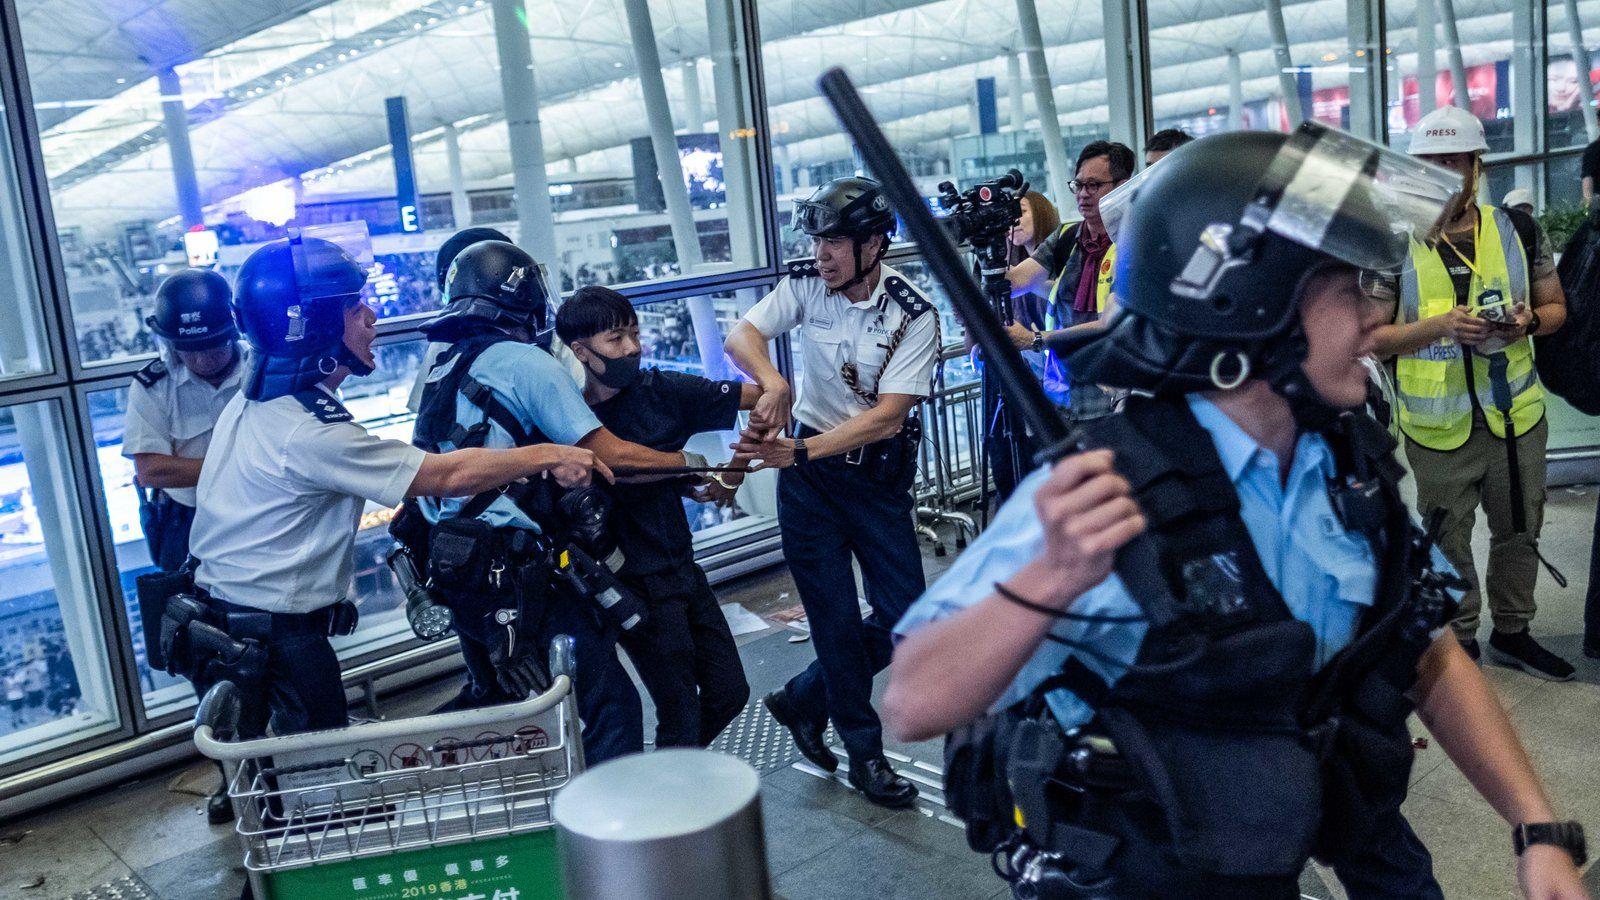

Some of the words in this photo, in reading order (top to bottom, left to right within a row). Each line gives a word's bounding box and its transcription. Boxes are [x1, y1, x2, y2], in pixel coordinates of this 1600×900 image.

[1425, 128, 1457, 137] PRESS
[402, 205, 418, 232] E
[178, 326, 208, 336] Police
